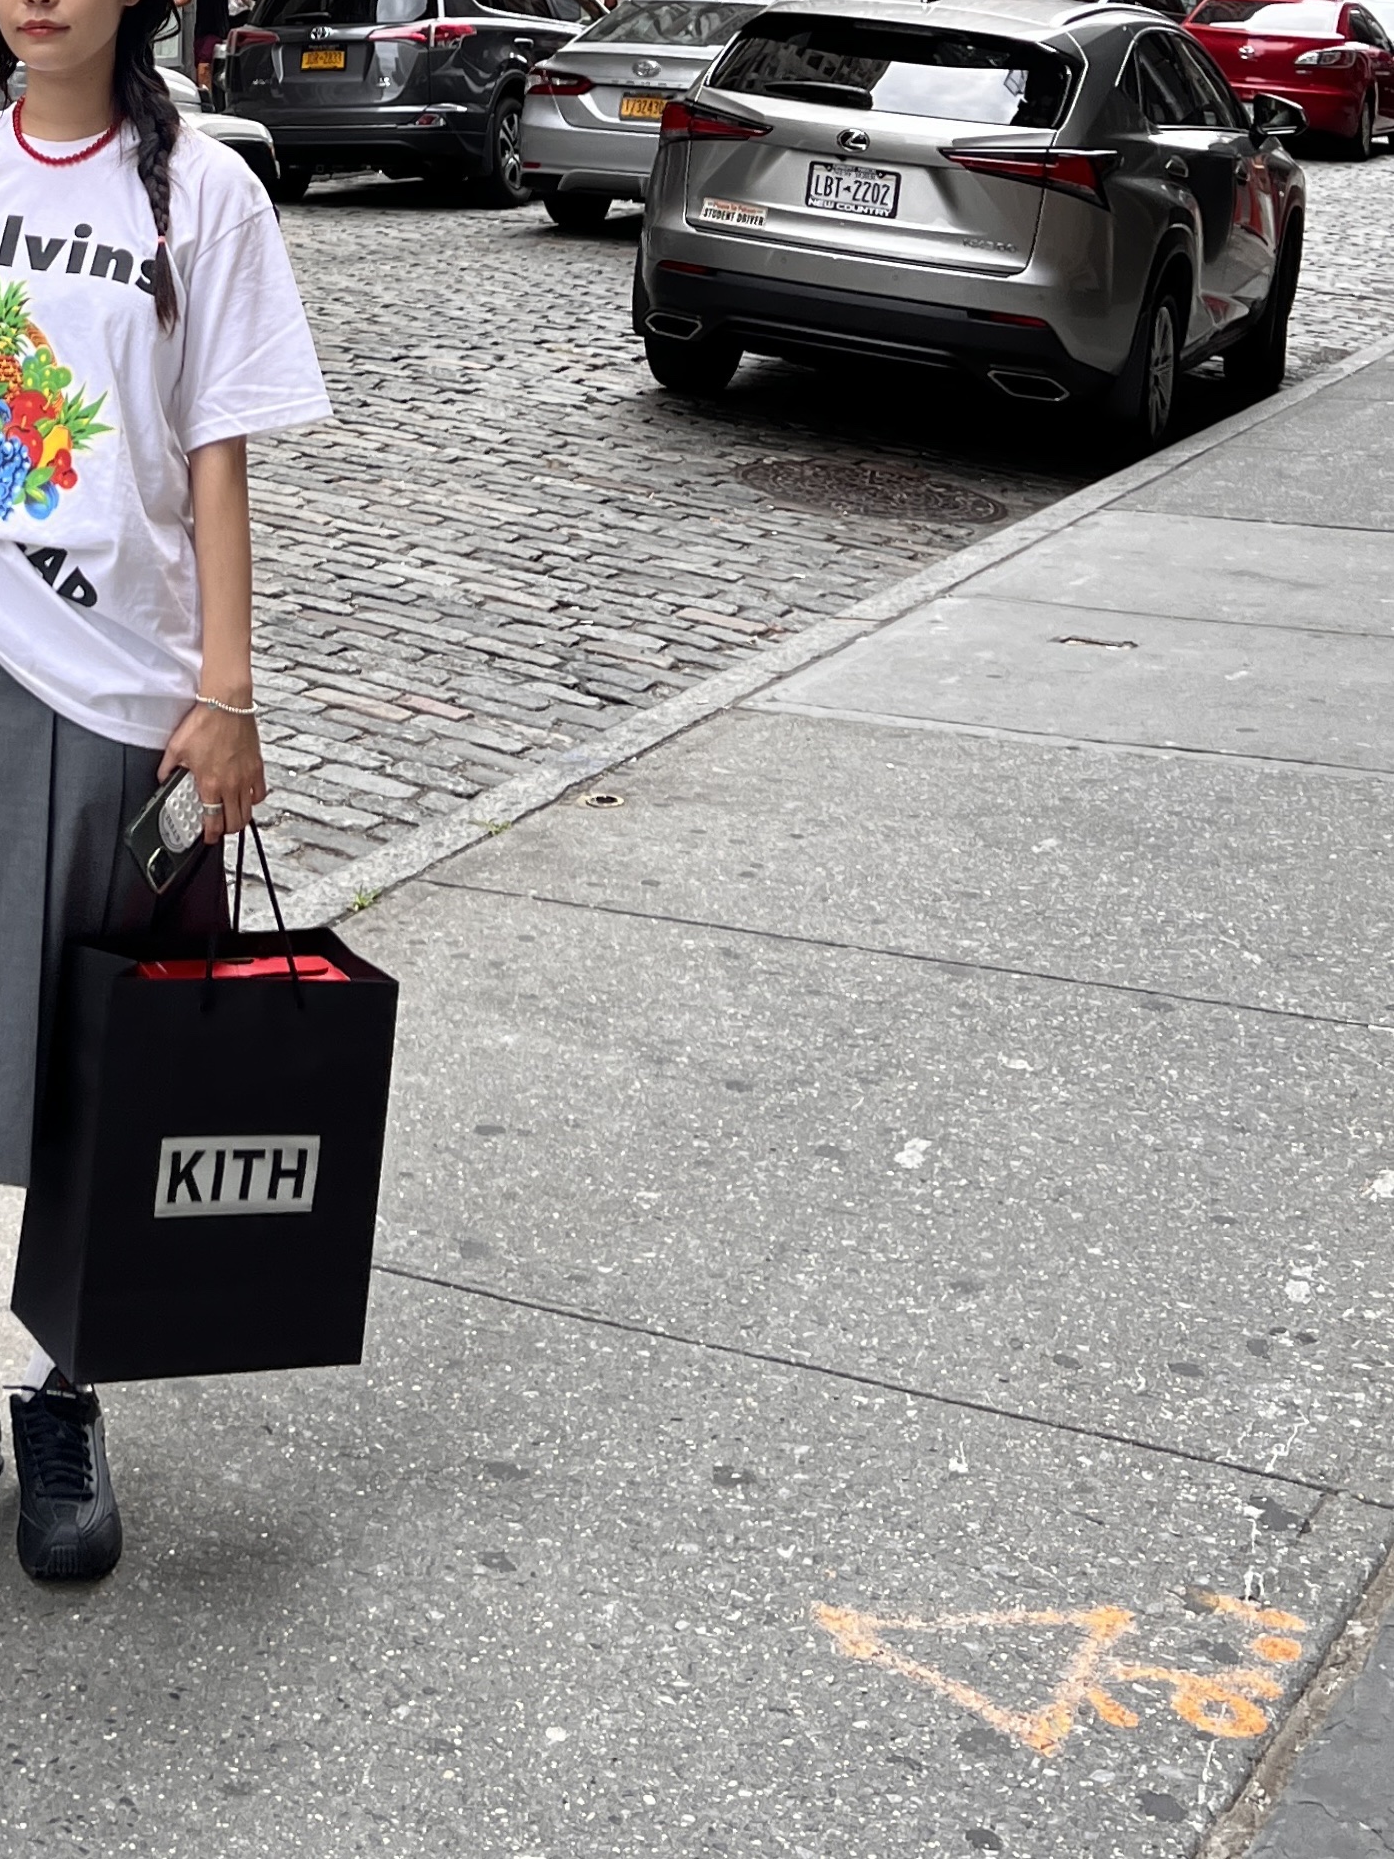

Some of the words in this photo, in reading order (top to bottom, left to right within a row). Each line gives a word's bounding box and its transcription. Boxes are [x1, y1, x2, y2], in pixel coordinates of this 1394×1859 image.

[703, 208, 735, 221] STUDENT
[736, 212, 765, 226] DRIVER
[808, 198, 835, 210] NEW
[836, 202, 891, 217] COUNTRY
[167, 1149, 308, 1203] KITH
